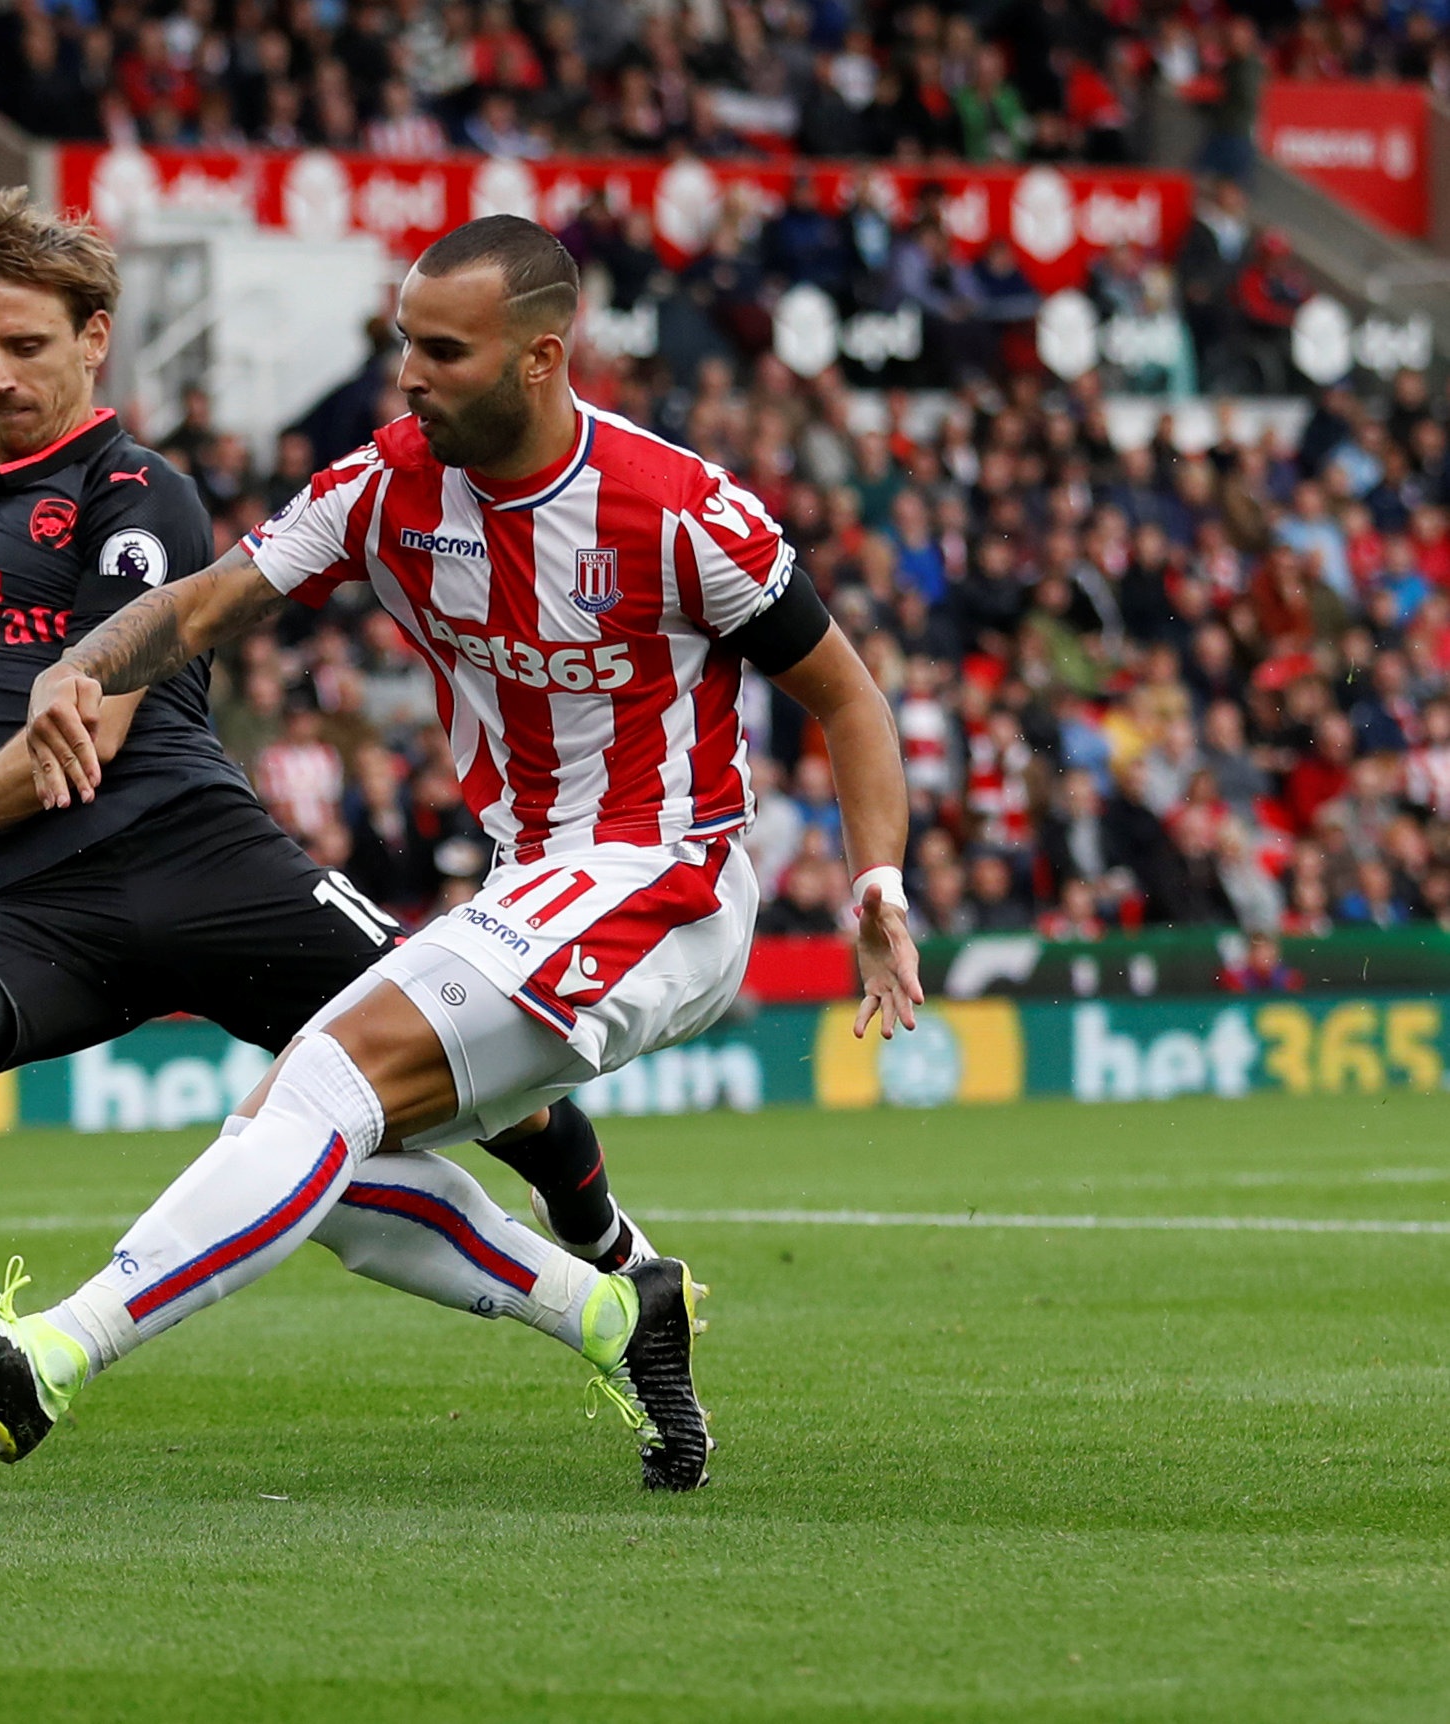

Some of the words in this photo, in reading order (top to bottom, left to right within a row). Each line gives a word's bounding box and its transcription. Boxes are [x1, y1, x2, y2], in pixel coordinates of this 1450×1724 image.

[400, 528, 487, 559] macron
[579, 552, 612, 562] STOKE
[419, 606, 635, 691] bet365
[497, 866, 597, 931] 11
[457, 905, 532, 958] macron
[1072, 1000, 1443, 1104] bet365
